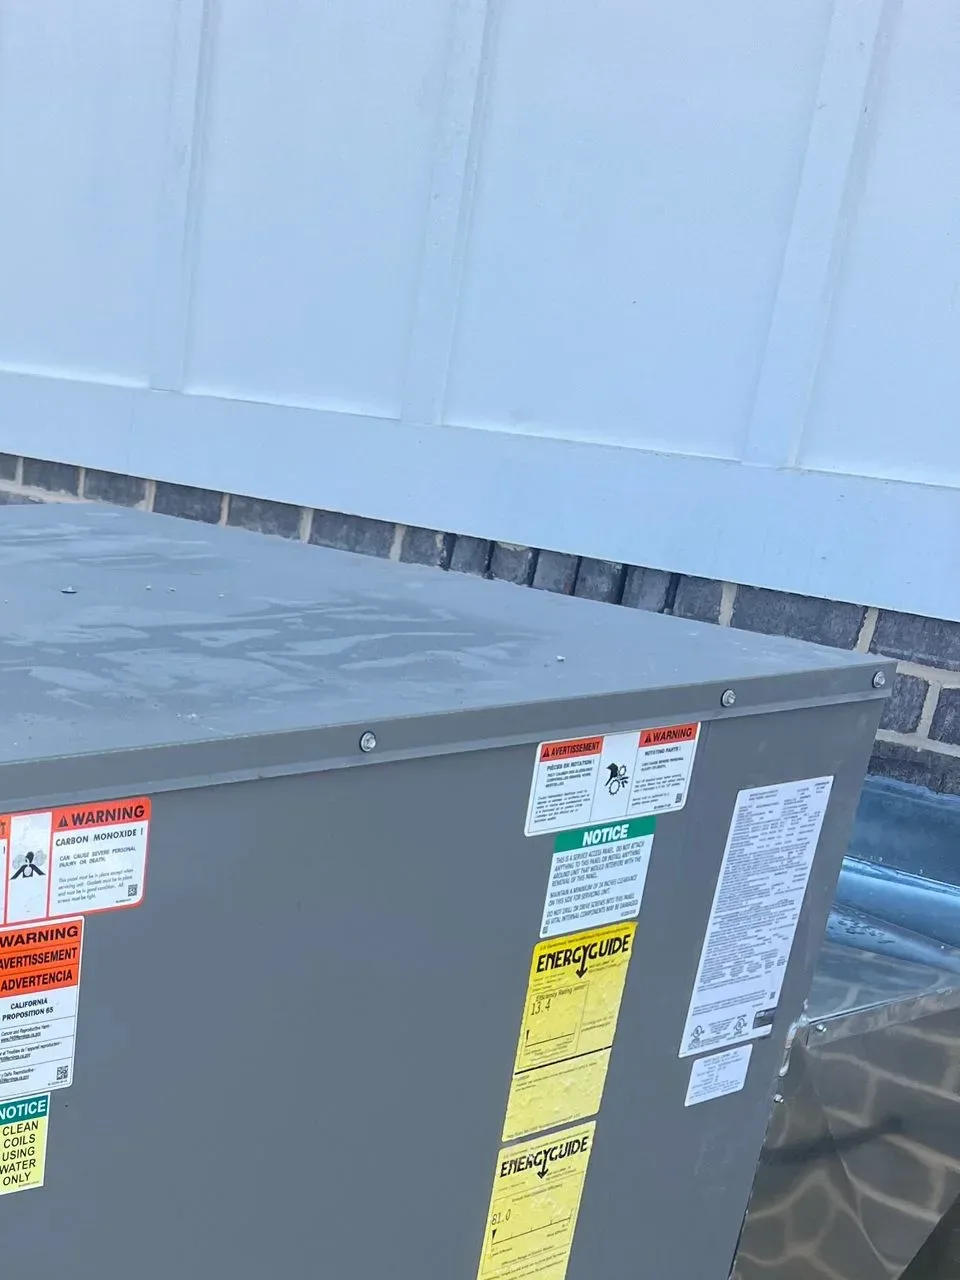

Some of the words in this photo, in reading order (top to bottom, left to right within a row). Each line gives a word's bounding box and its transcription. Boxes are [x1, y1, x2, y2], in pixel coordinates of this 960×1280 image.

[653, 728, 692, 742] WARNING
[551, 742, 600, 756] AVERTISSEMENT
[72, 805, 144, 825] WARNING
[56, 835, 89, 846] CARBON
[94, 829, 136, 841] MONOXIDE
[583, 824, 629, 846] NOTICE
[0, 926, 78, 948] WARNING
[536, 934, 631, 978] ENERGYGUIDE
[1, 969, 72, 991] ADVERTENCIA
[11, 998, 48, 1010] CALIFORNIA
[2, 1008, 44, 1021] PROPOSITION
[3, 1120, 38, 1136] CLEAN
[4, 1134, 35, 1148] COILS
[2, 1147, 35, 1161] USING
[500, 1136, 589, 1178] ENERGYGUIDE
[0, 1159, 36, 1174] WATER
[3, 1172, 31, 1185] ONLY
[491, 1209, 511, 1226] 81.0
